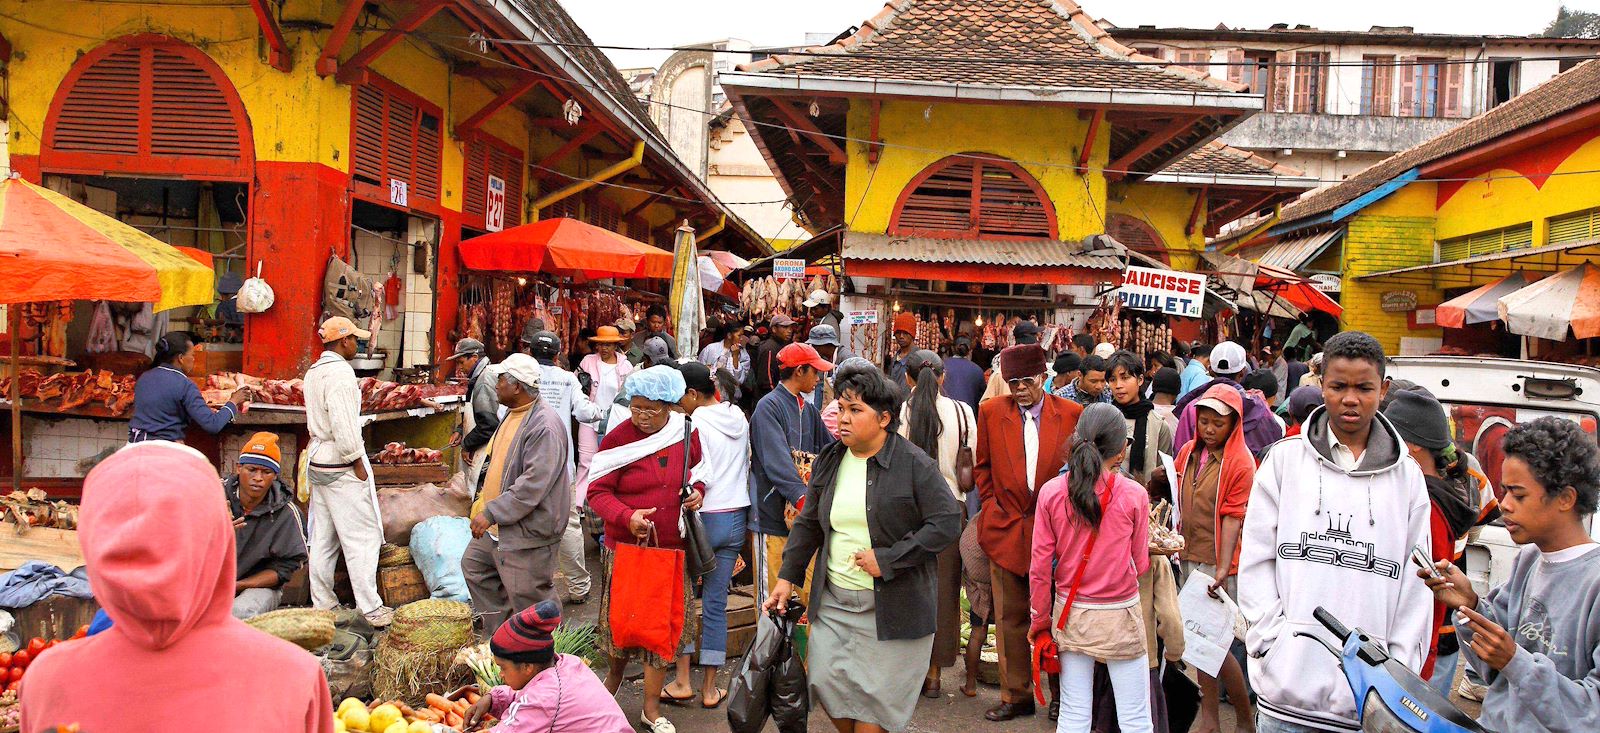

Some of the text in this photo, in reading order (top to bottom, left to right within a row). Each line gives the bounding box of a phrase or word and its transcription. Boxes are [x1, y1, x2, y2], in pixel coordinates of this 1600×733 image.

[1118, 291, 1192, 314] POULET
[1308, 531, 1368, 549] damani
[1277, 531, 1400, 580] dada
[1401, 696, 1428, 720] YAMAHA
